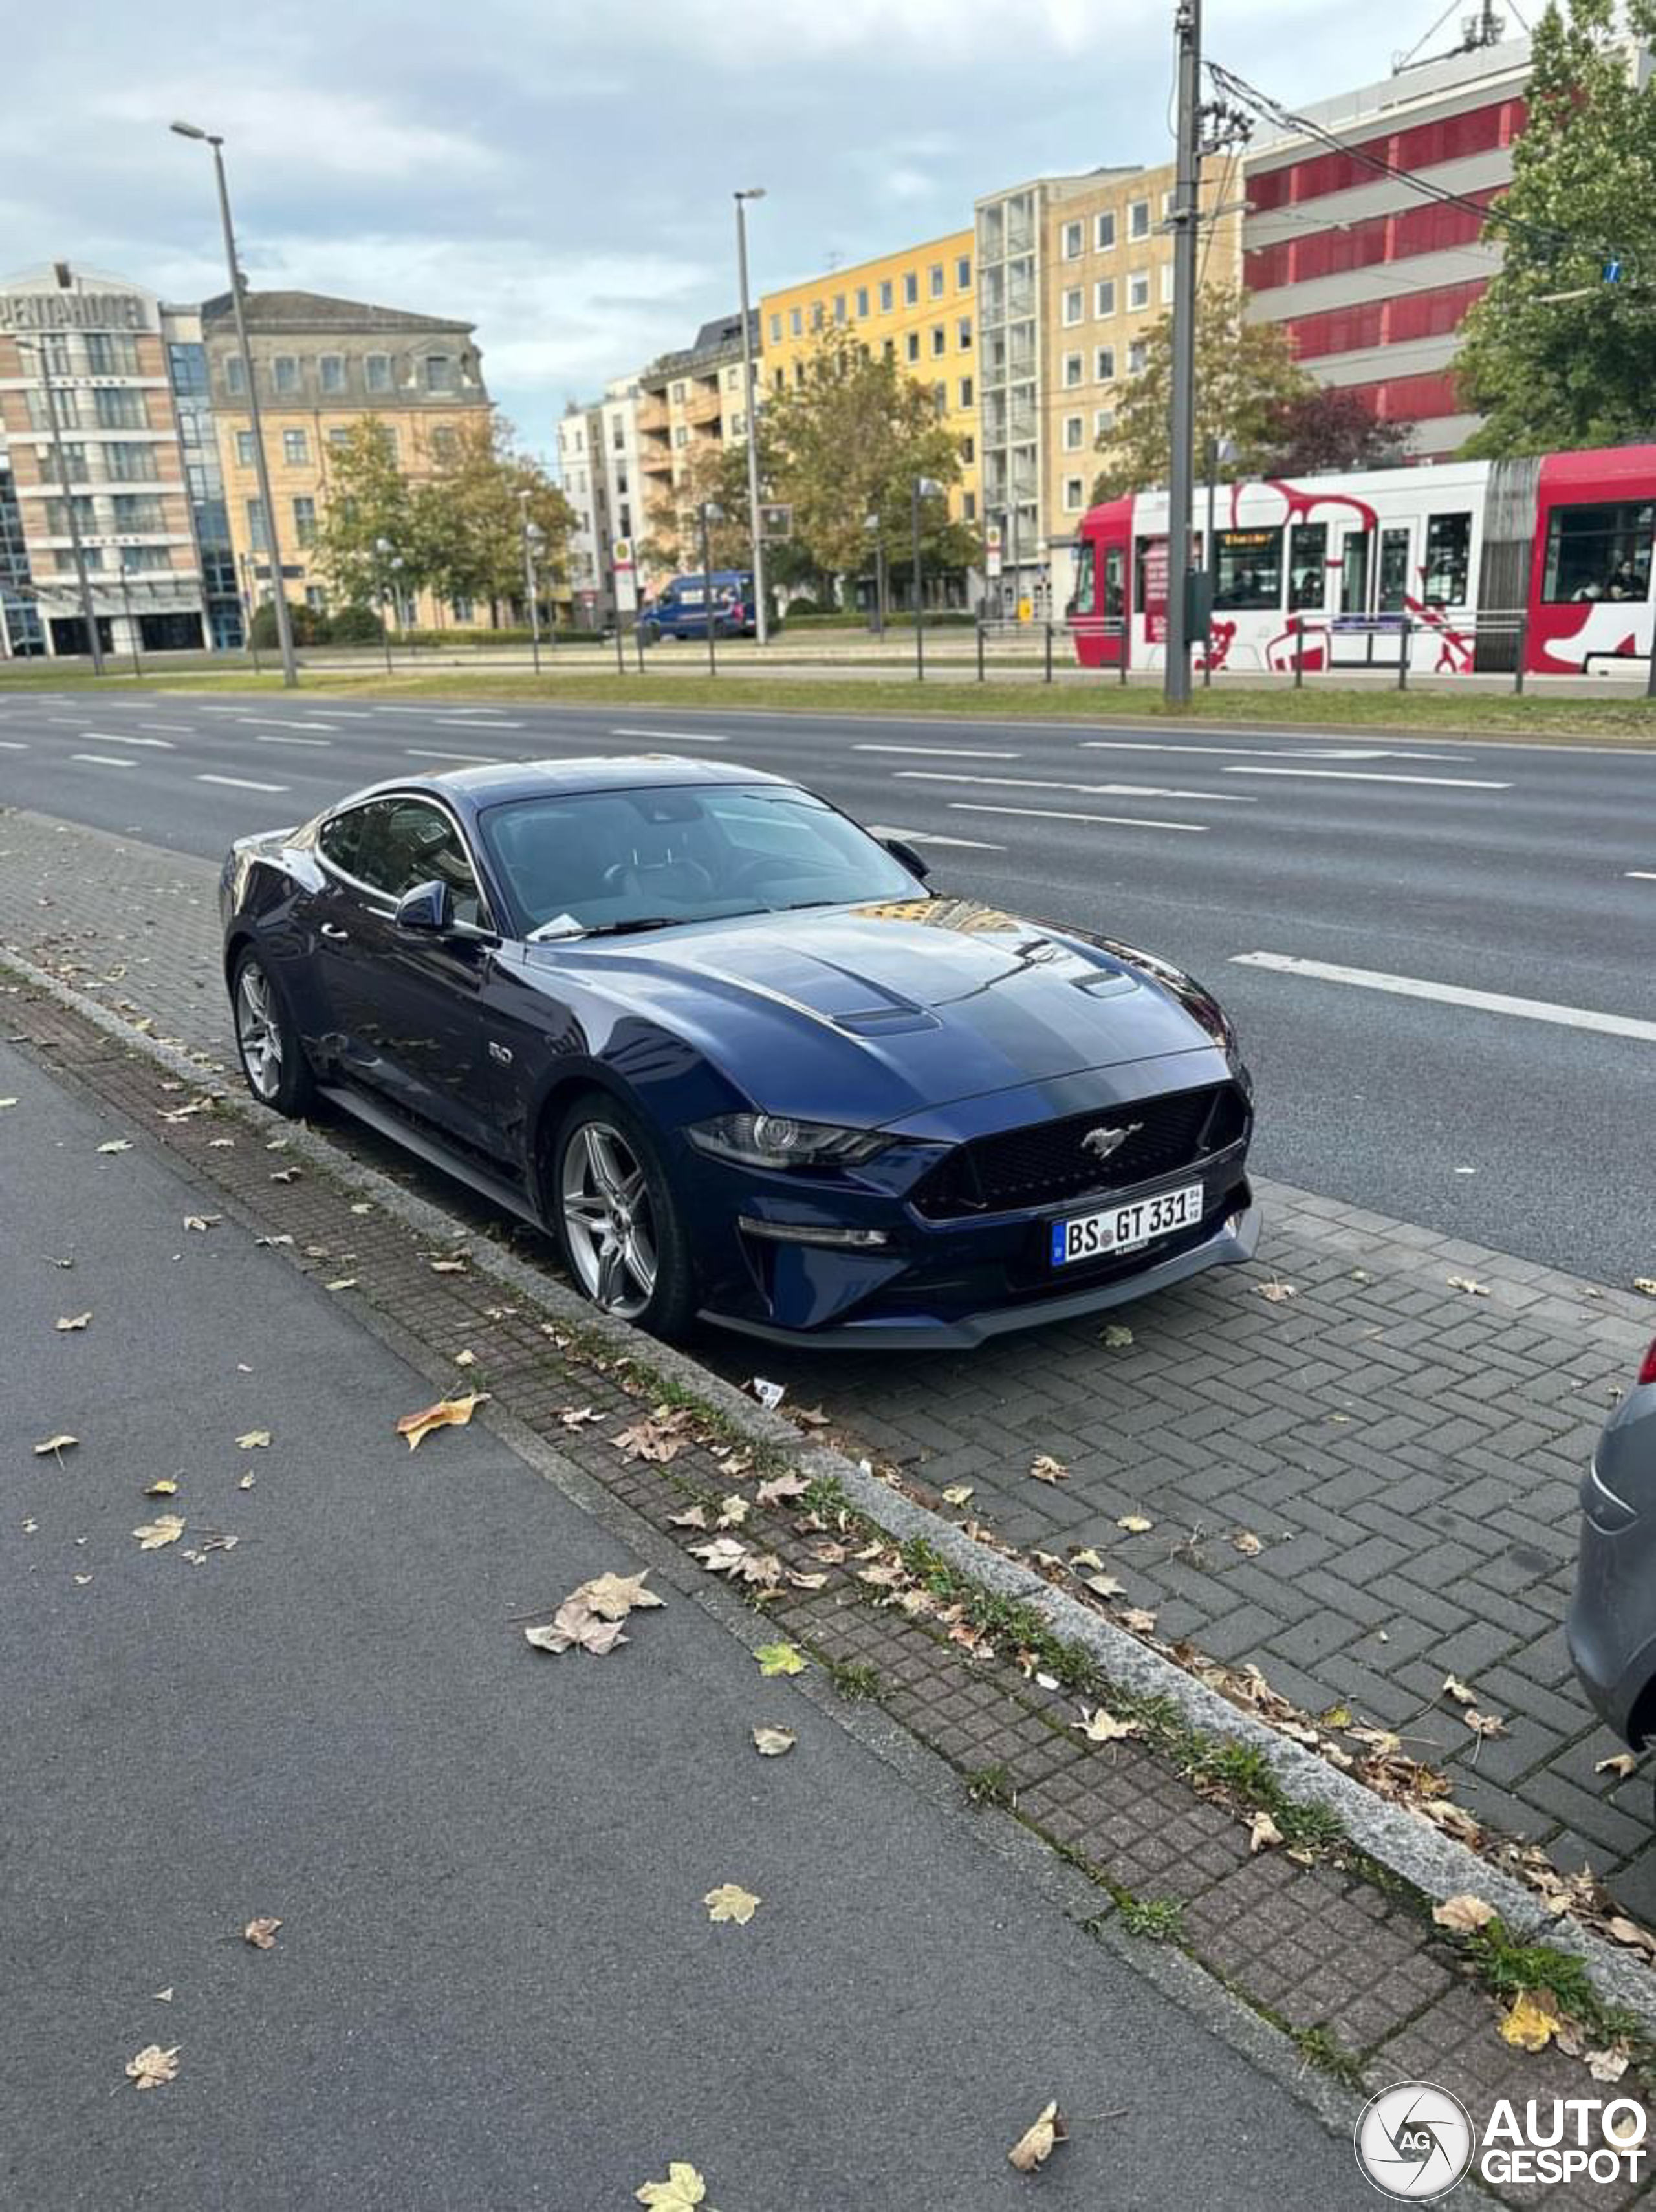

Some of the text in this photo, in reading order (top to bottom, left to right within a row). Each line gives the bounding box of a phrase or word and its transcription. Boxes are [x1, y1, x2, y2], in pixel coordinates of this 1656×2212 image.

[1069, 1219, 1098, 1256] BS
[1117, 1206, 1144, 1242] GT
[1149, 1193, 1186, 1231] 331
